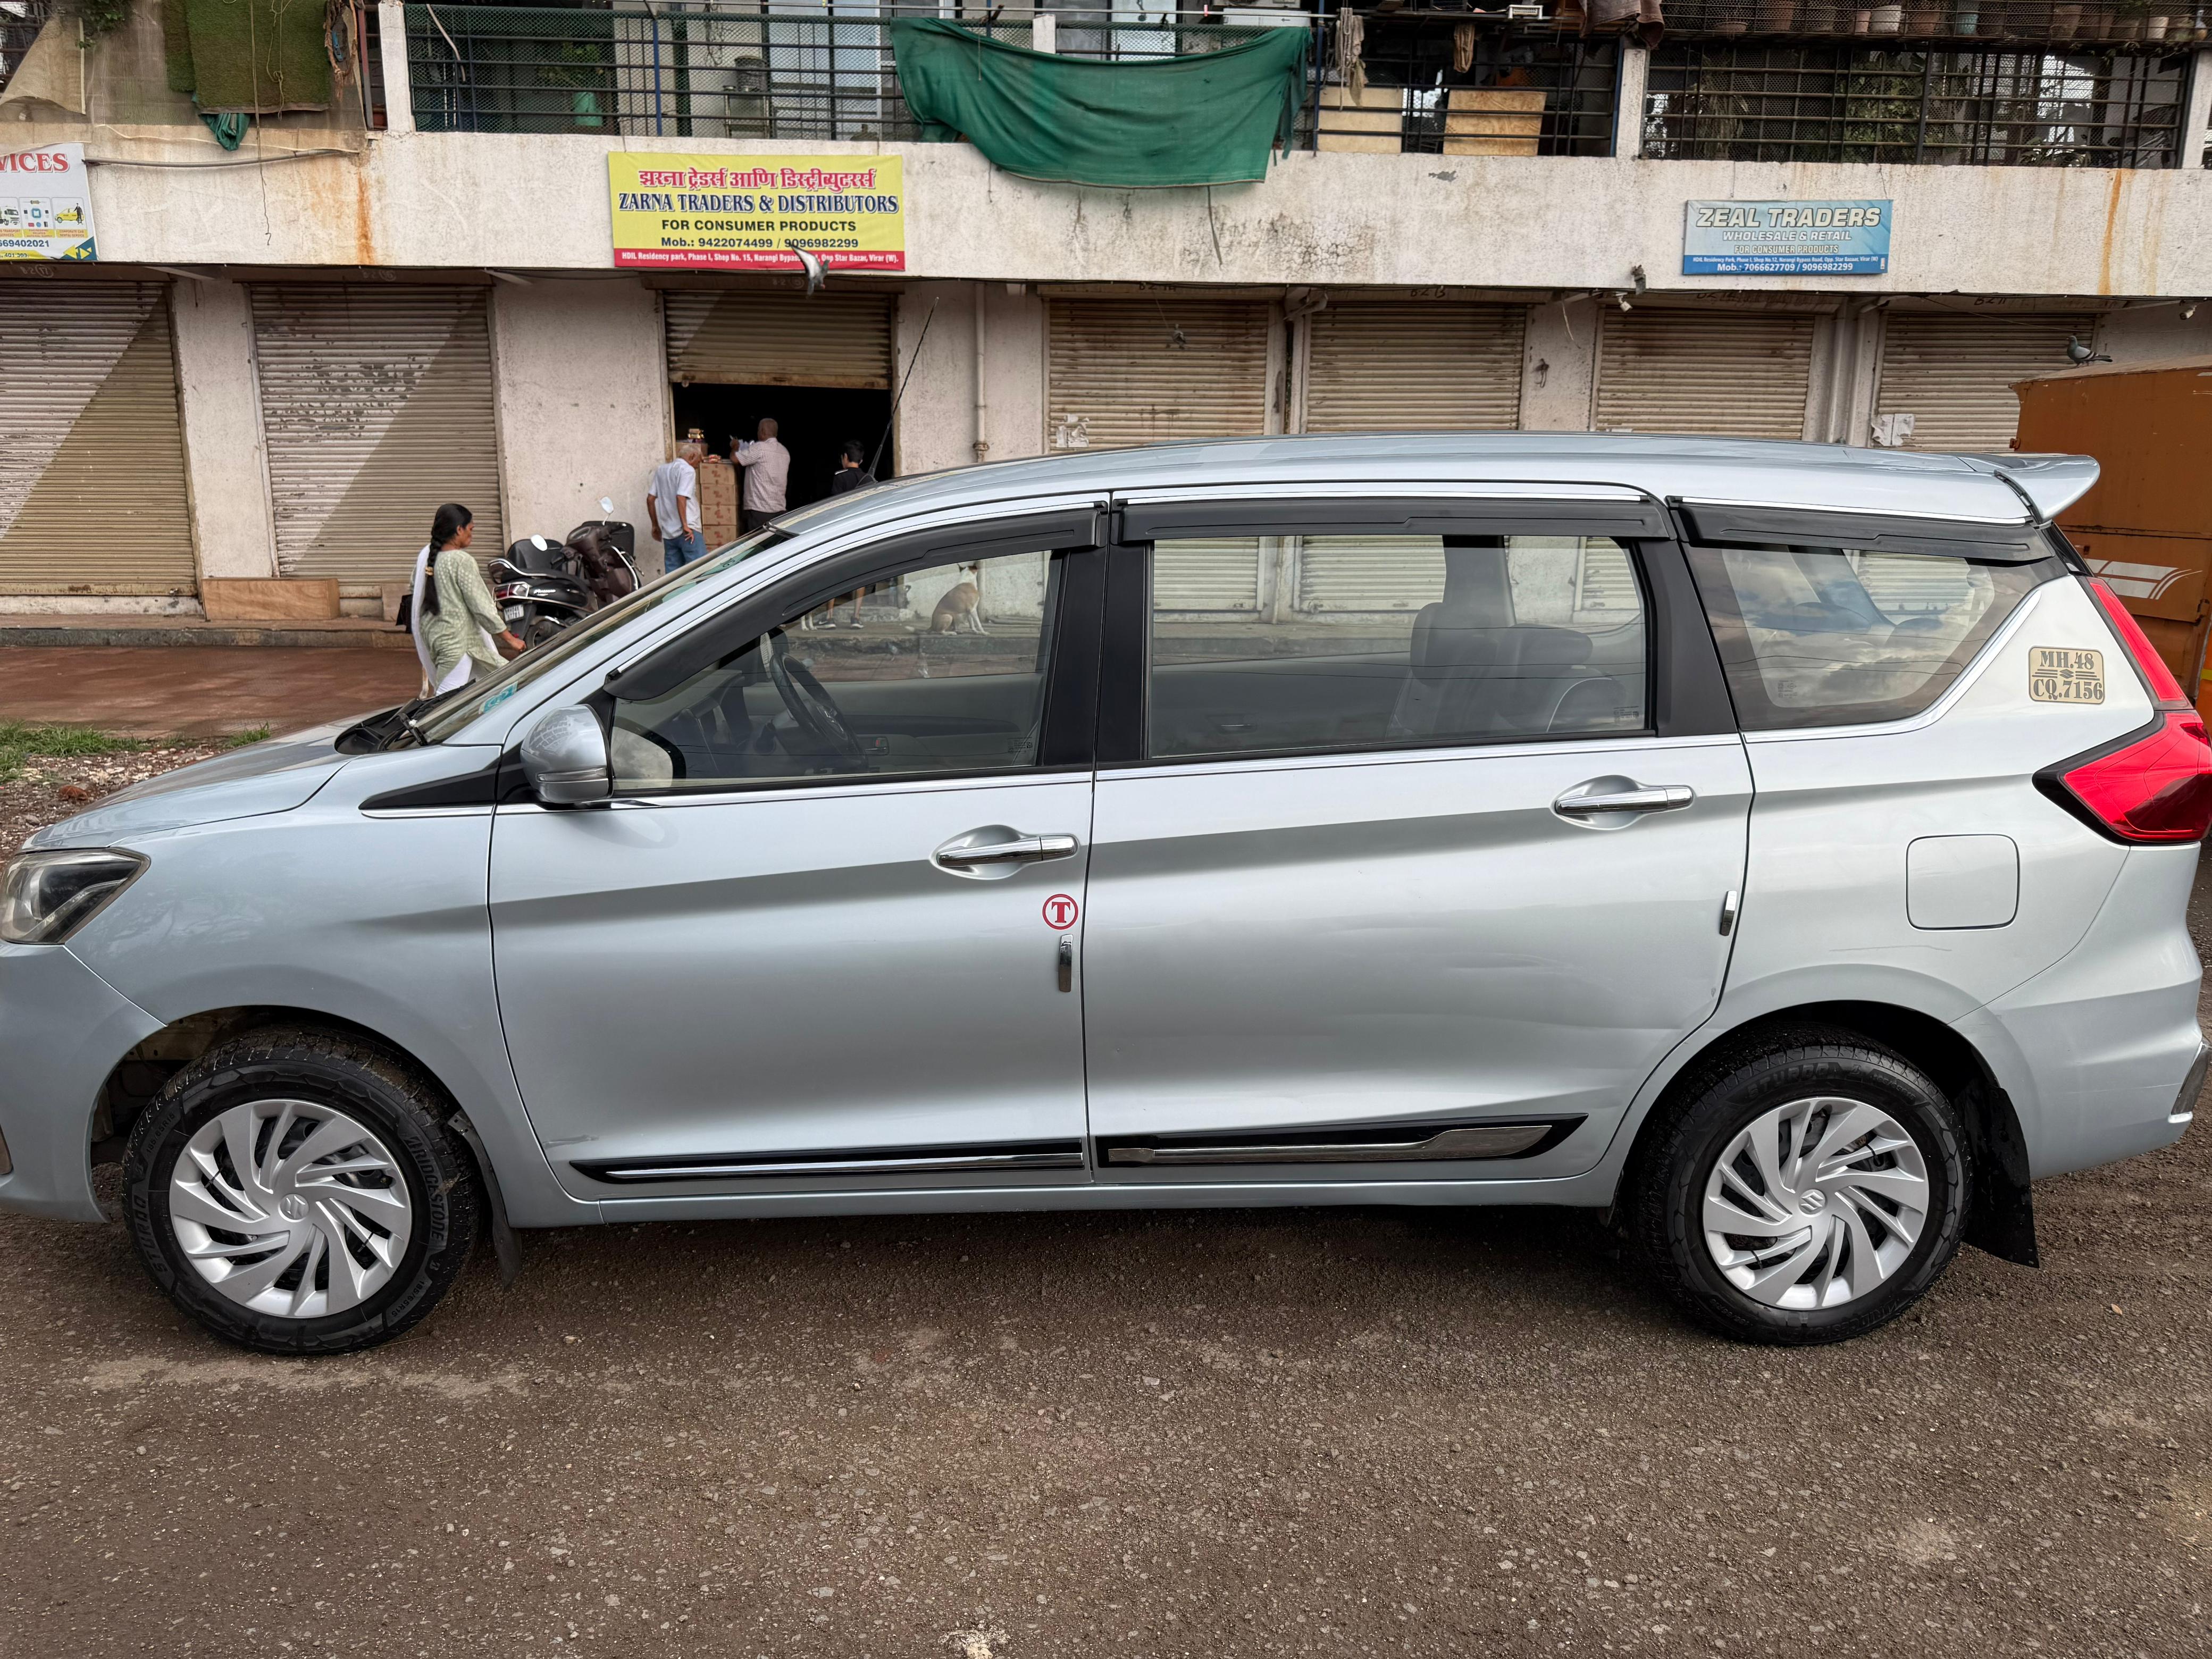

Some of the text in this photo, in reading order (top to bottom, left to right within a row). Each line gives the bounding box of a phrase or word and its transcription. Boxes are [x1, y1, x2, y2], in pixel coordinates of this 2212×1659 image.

[639, 170, 685, 187] झरना
[688, 167, 728, 190] ट्रेडर्स
[730, 168, 777, 189] आणि
[619, 193, 899, 214] ZARNA TRADERS & DISTRIBUTORS
[661, 220, 856, 232] FOR CONSUMER PRODUCTS
[1696, 207, 1881, 228] ZEAL TRADERS
[661, 237, 858, 248] Mob.: 9422074499 / 9096982299
[1723, 231, 1852, 241] WHOLESALE & RETAIL
[638, 252, 669, 262] Residency
[671, 253, 686, 262] park,
[688, 253, 707, 261] Phase
[714, 253, 729, 262] Shop
[743, 254, 753, 263] 15,
[754, 254, 778, 263] Narangi
[1734, 245, 1839, 254] FOR CONSUMER PRODUCTS
[1796, 263, 1800, 272] /
[1802, 263, 1853, 271] 9096982299
[2040, 650, 2094, 670] MH.48
[2033, 678, 2104, 700] CQ.7156
[1051, 901, 1071, 923] T
[146, 1113, 175, 1153] 185/65R15
[134, 1195, 169, 1272] STURDO
[391, 1280, 425, 1317] 185/65R15
